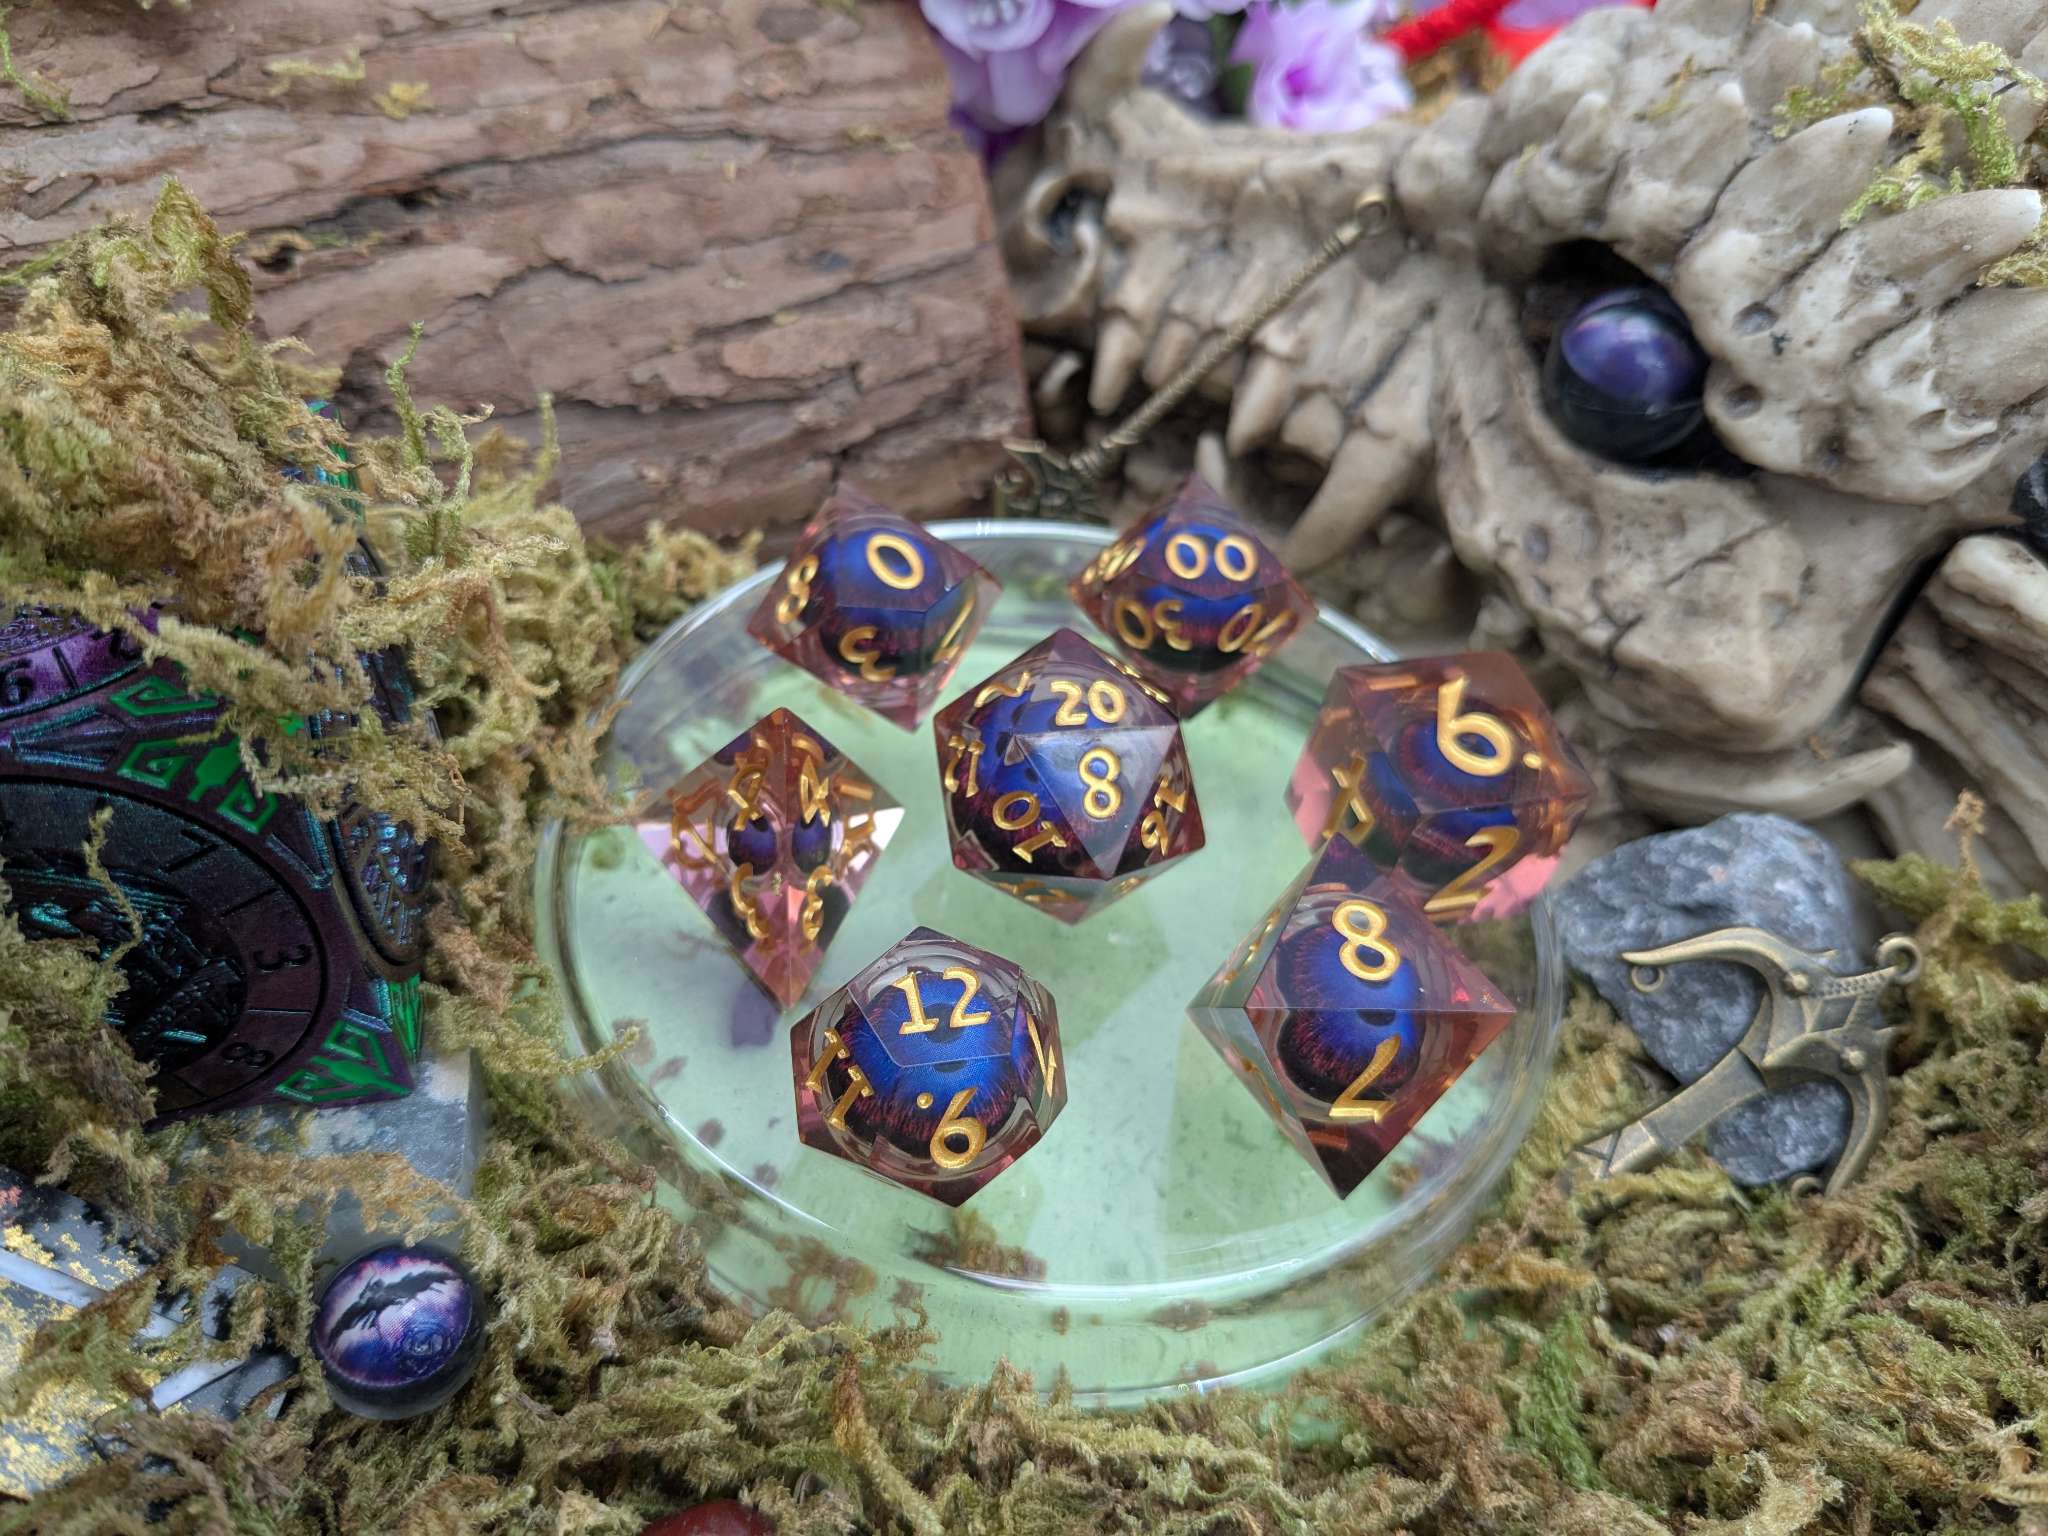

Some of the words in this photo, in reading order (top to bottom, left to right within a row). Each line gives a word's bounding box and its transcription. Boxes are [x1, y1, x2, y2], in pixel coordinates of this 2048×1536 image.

[866, 534, 925, 589] 0
[1165, 533, 1258, 581] 00
[1050, 680, 1127, 726] 20
[1078, 746, 1122, 820] 8
[1332, 899, 1401, 982] 8
[890, 966, 992, 1036] 12
